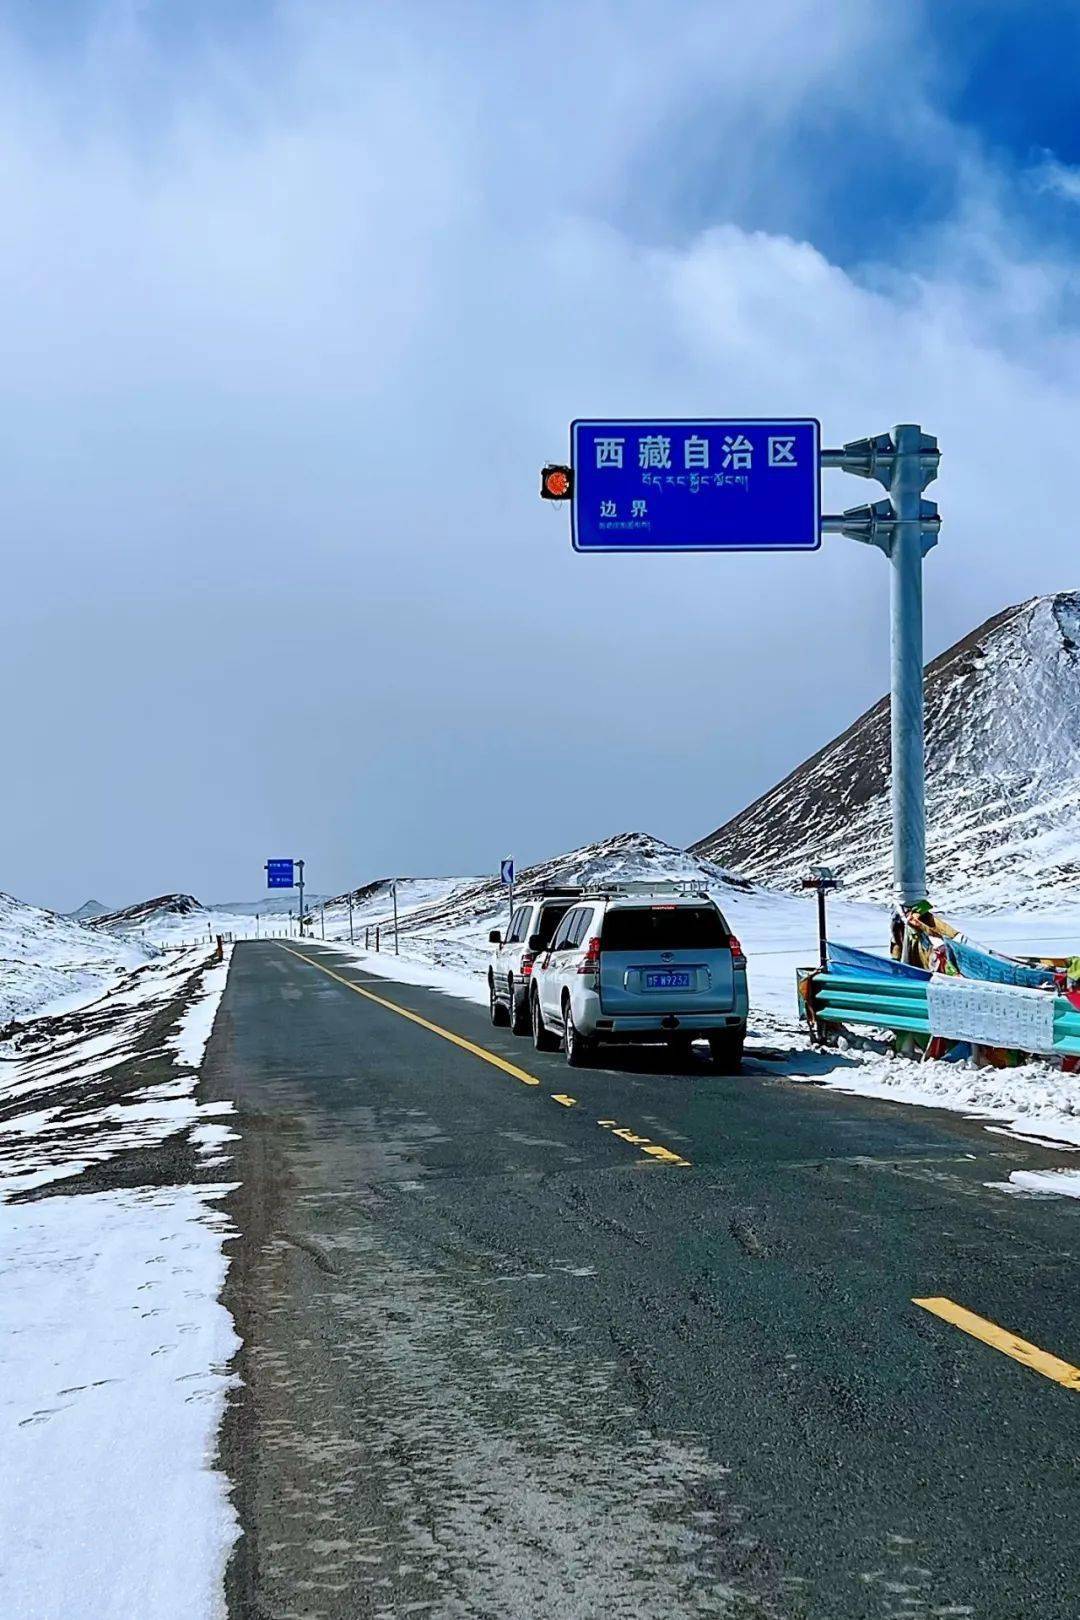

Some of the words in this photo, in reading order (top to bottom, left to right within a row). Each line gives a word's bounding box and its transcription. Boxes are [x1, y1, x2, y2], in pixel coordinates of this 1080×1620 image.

[594, 435, 798, 470] 西藏自治区
[600, 500, 648, 518] 边界
